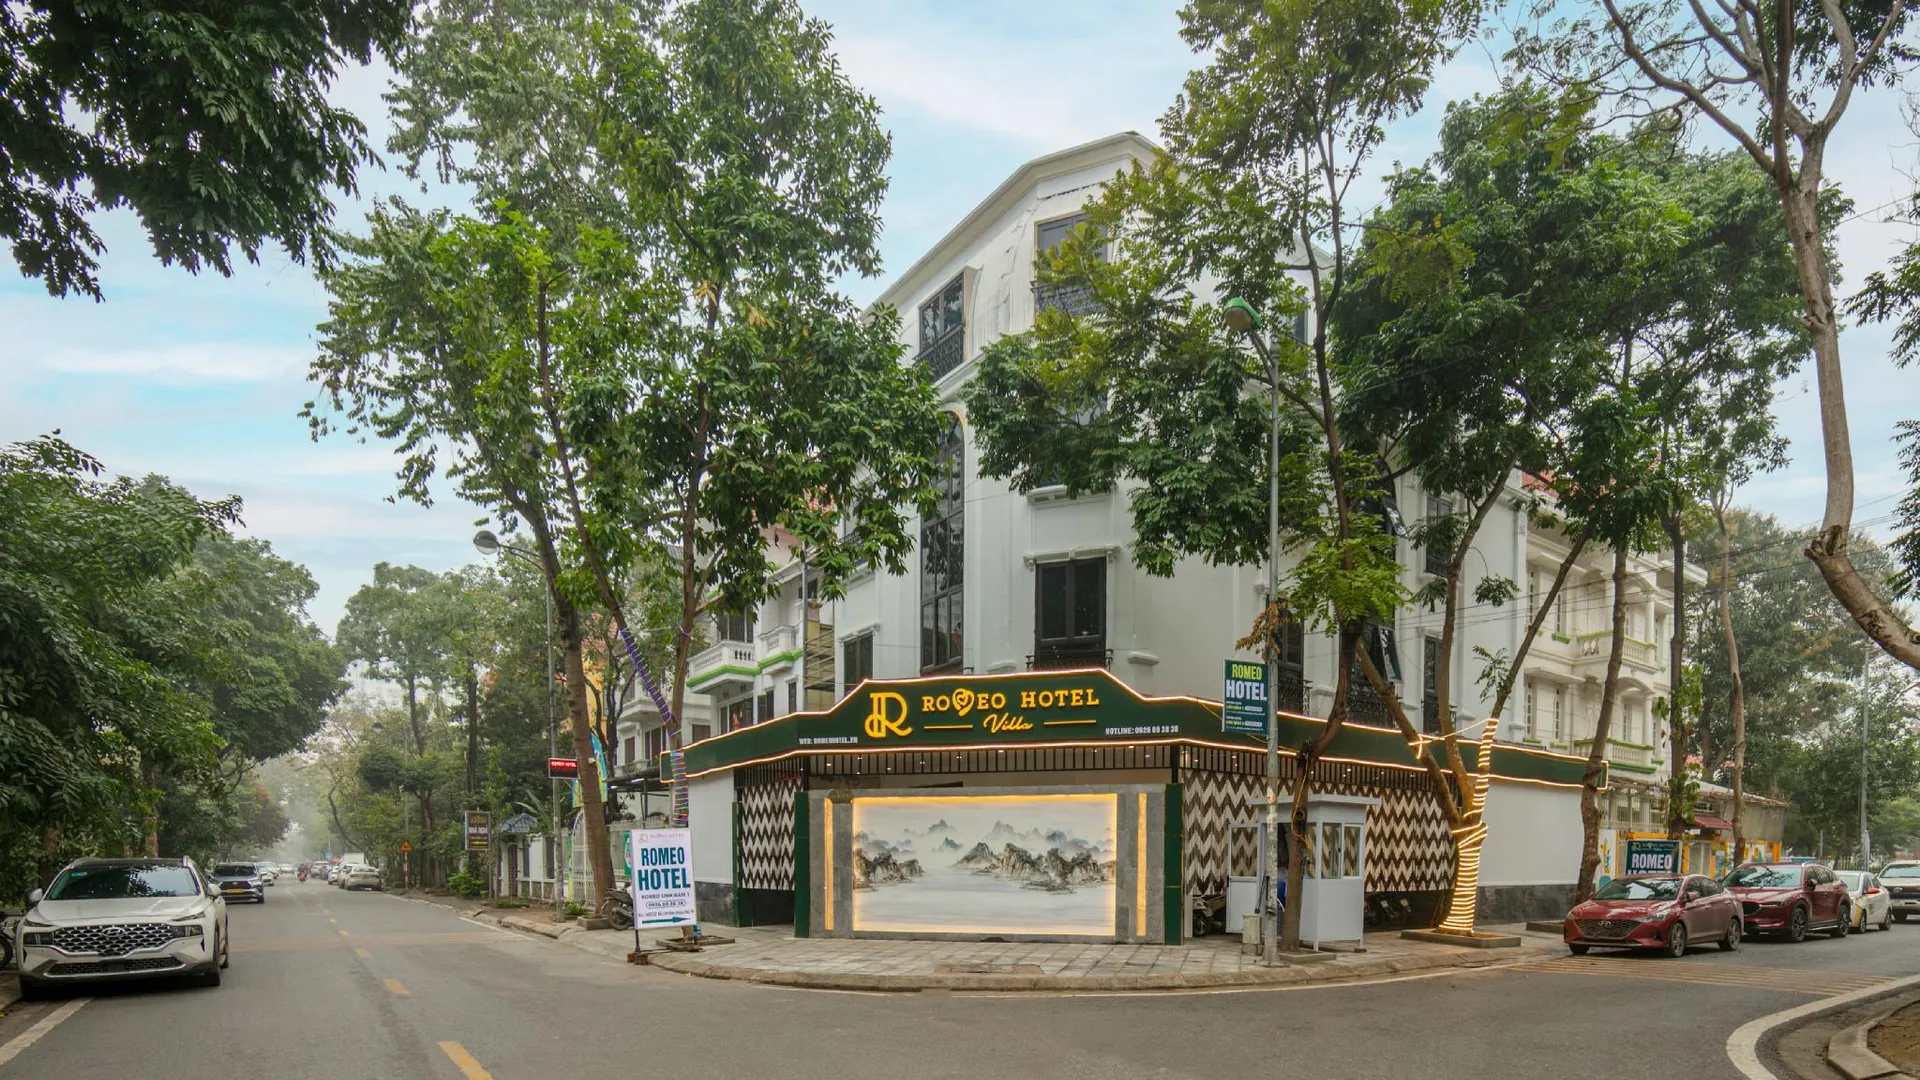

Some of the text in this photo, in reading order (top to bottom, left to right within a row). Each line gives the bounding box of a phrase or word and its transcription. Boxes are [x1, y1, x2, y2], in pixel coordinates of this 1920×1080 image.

[1231, 664, 1262, 680] ROMEO
[1020, 688, 1099, 708] HOTEL
[1226, 680, 1267, 701] HOTEL
[983, 712, 1033, 734] Villa
[641, 846, 685, 866] ROMEO
[1632, 853, 1673, 869] ROMEO
[638, 867, 691, 890] HOTEL
